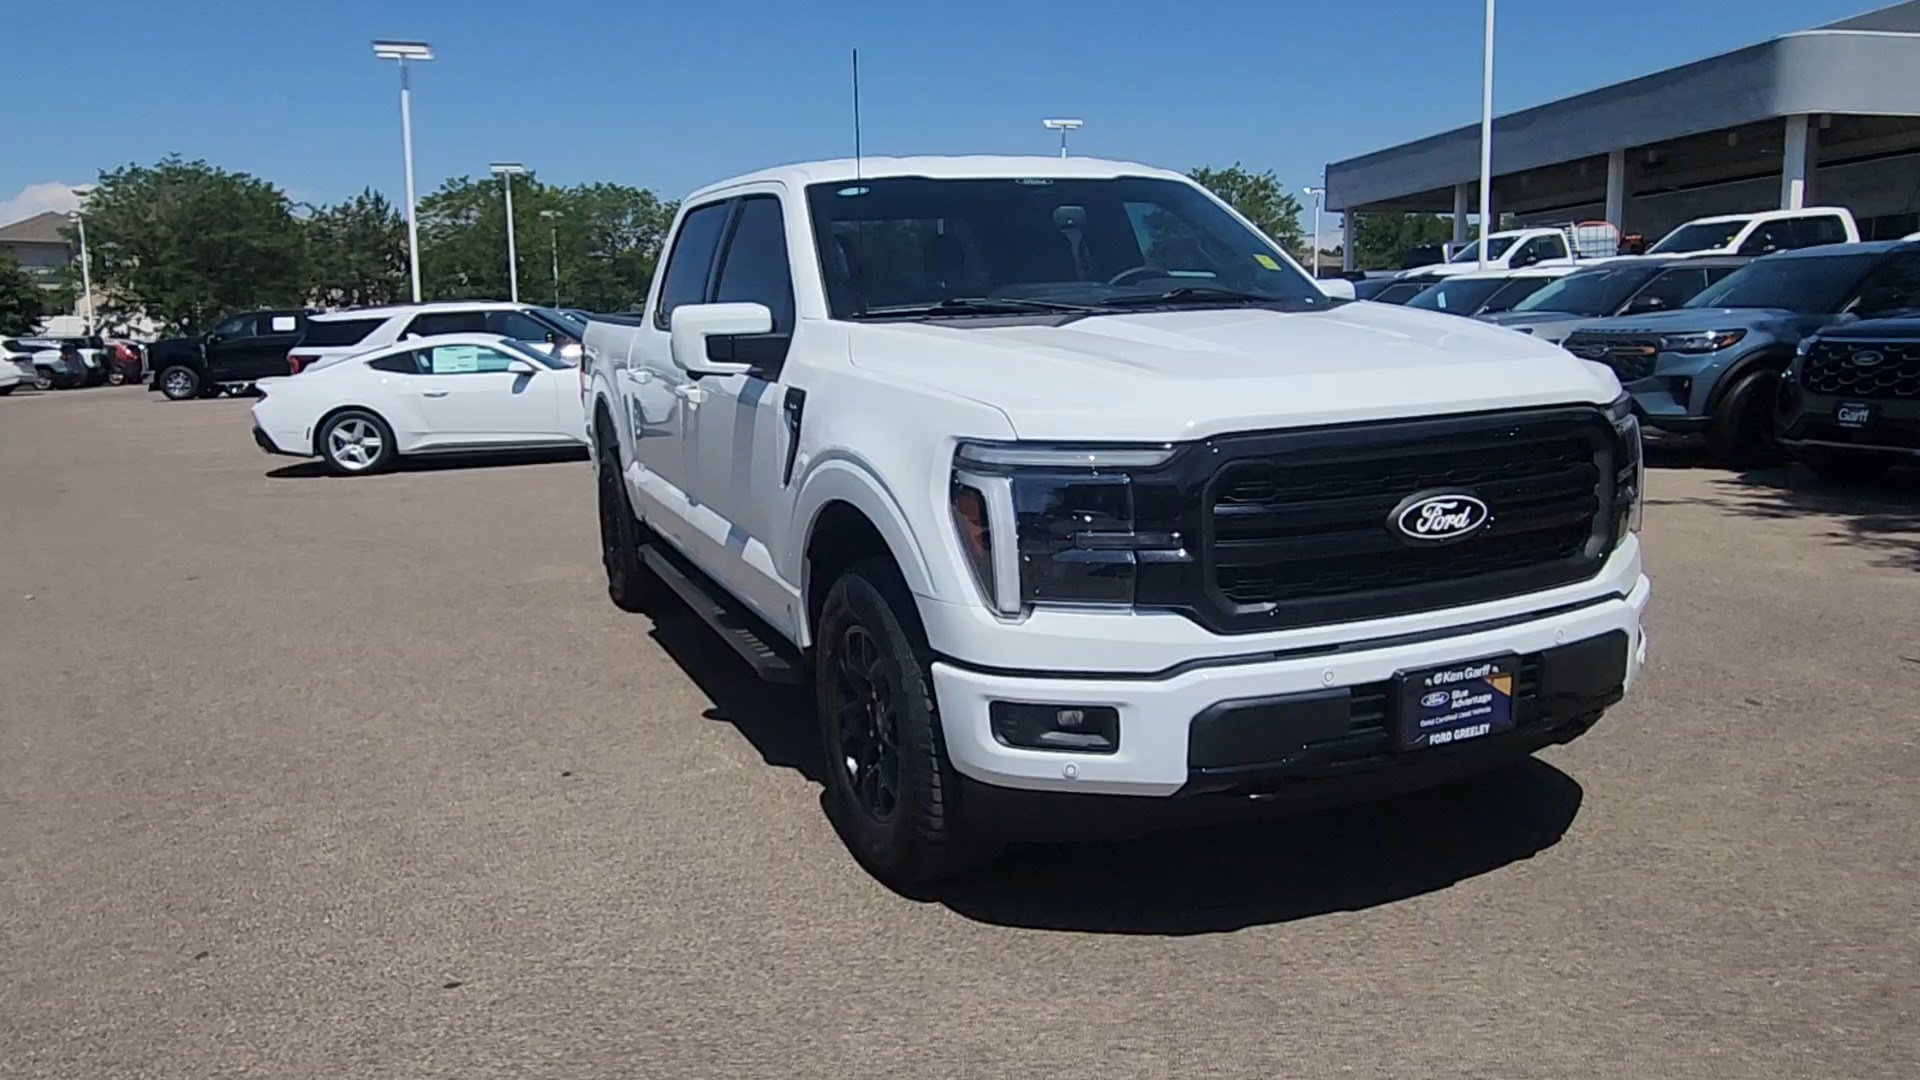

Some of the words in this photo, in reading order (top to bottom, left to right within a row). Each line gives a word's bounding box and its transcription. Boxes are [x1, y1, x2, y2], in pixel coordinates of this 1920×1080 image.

[1416, 501, 1472, 533] Ford
[1443, 670, 1463, 684] Ken
[1465, 664, 1491, 680] Garff
[1429, 731, 1452, 745] FORD
[1454, 723, 1491, 740] GREELEY
